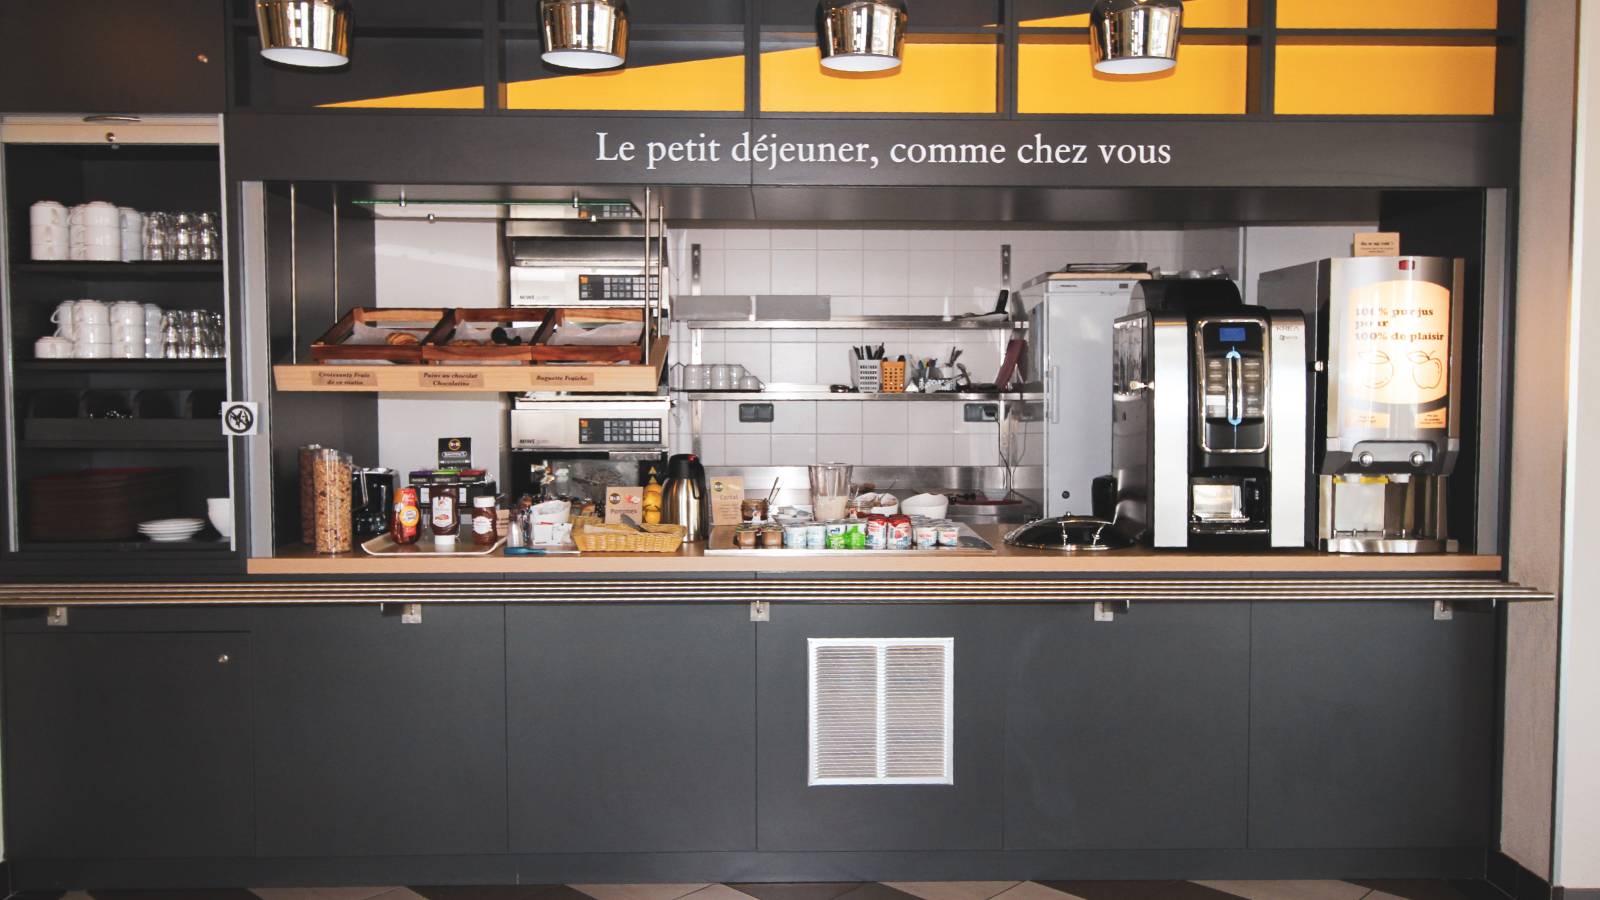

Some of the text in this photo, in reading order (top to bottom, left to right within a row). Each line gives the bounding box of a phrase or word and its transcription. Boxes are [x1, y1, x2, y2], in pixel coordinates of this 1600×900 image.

[595, 131, 1172, 171] Le petit déjeuner, comme chez vous
[1418, 307, 1434, 318] jus
[1410, 331, 1444, 343] plaisir
